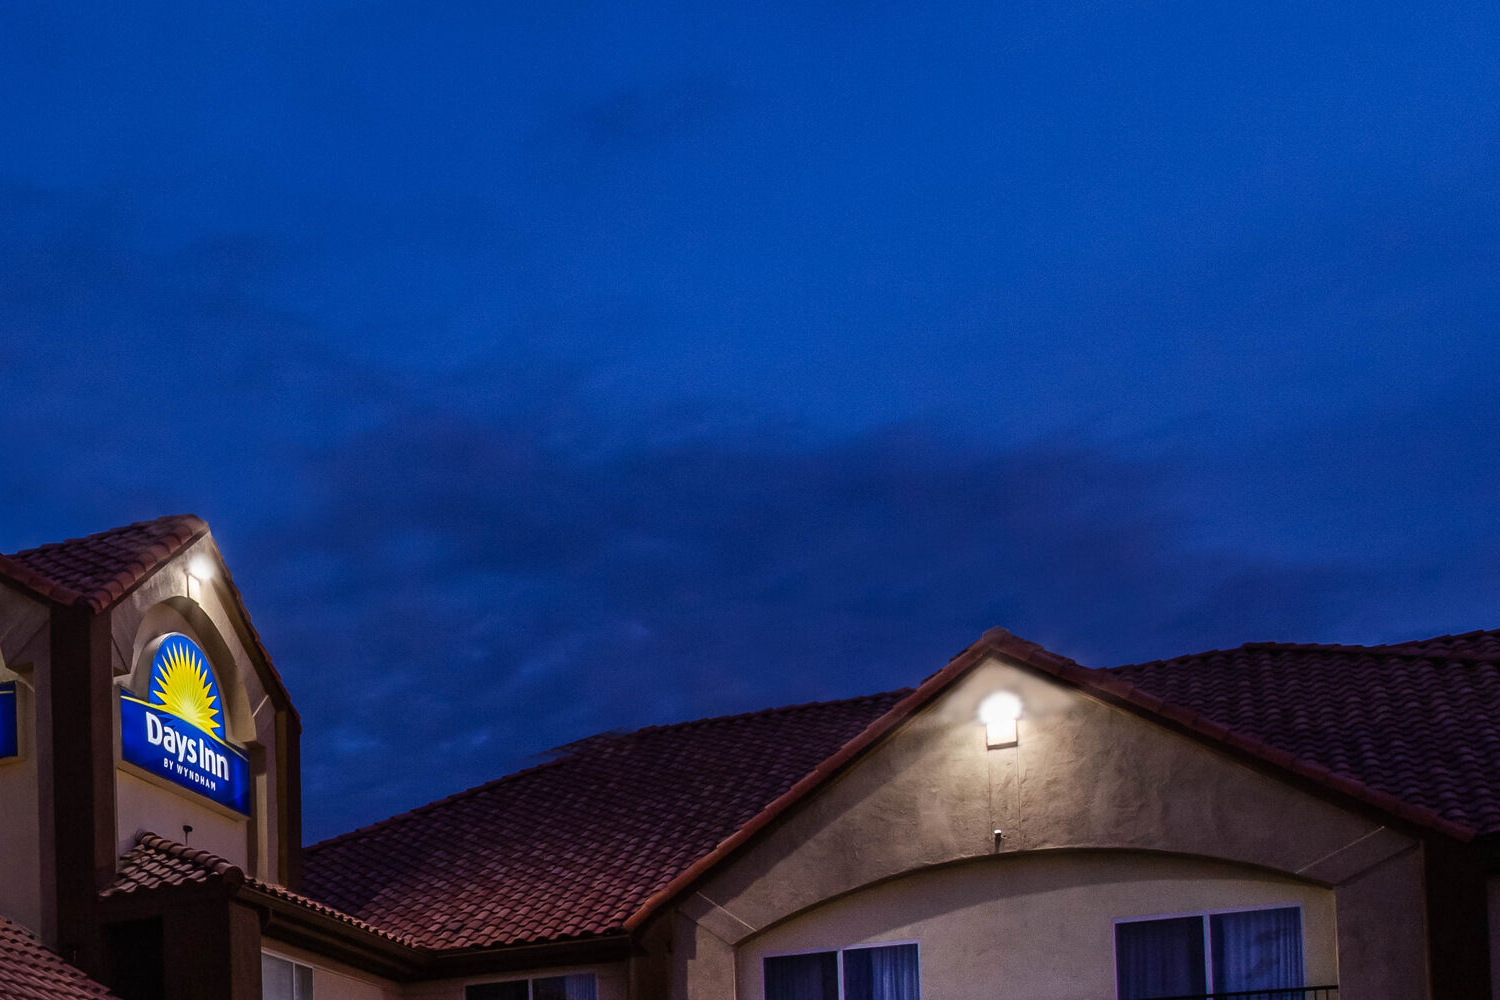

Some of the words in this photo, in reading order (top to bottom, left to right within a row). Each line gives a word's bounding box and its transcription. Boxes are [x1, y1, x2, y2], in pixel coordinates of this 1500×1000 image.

[146, 711, 197, 763] Days
[199, 738, 229, 781] Inn
[163, 758, 174, 770] BY
[176, 764, 216, 791] WYNDHAM
